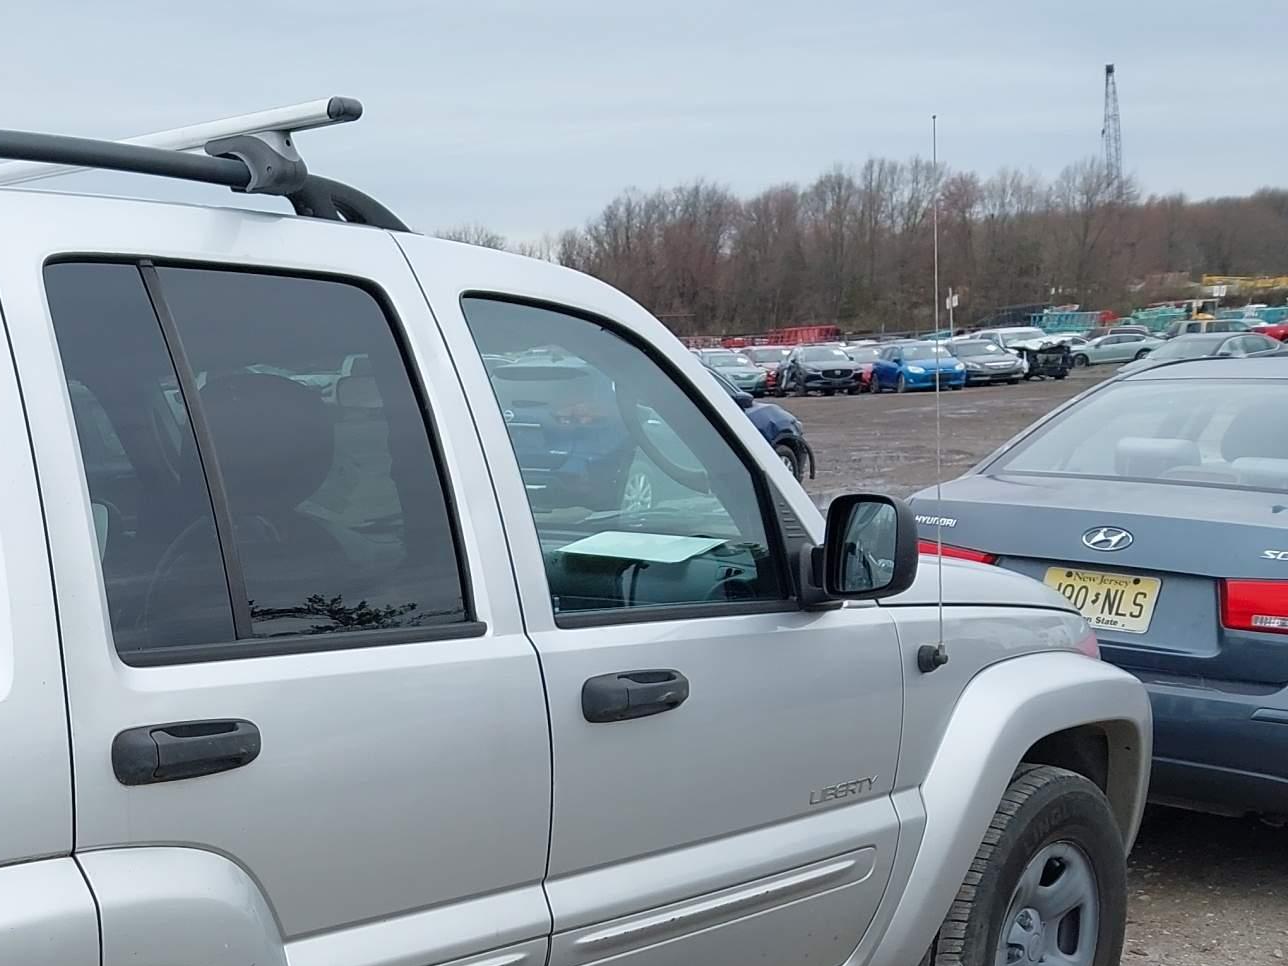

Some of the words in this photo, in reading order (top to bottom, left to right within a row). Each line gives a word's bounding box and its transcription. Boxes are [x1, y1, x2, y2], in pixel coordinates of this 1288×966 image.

[1072, 571, 1097, 583] New
[1098, 574, 1132, 588] Jersey
[1095, 617, 1119, 627] State
[809, 775, 879, 805] LIBERTY
